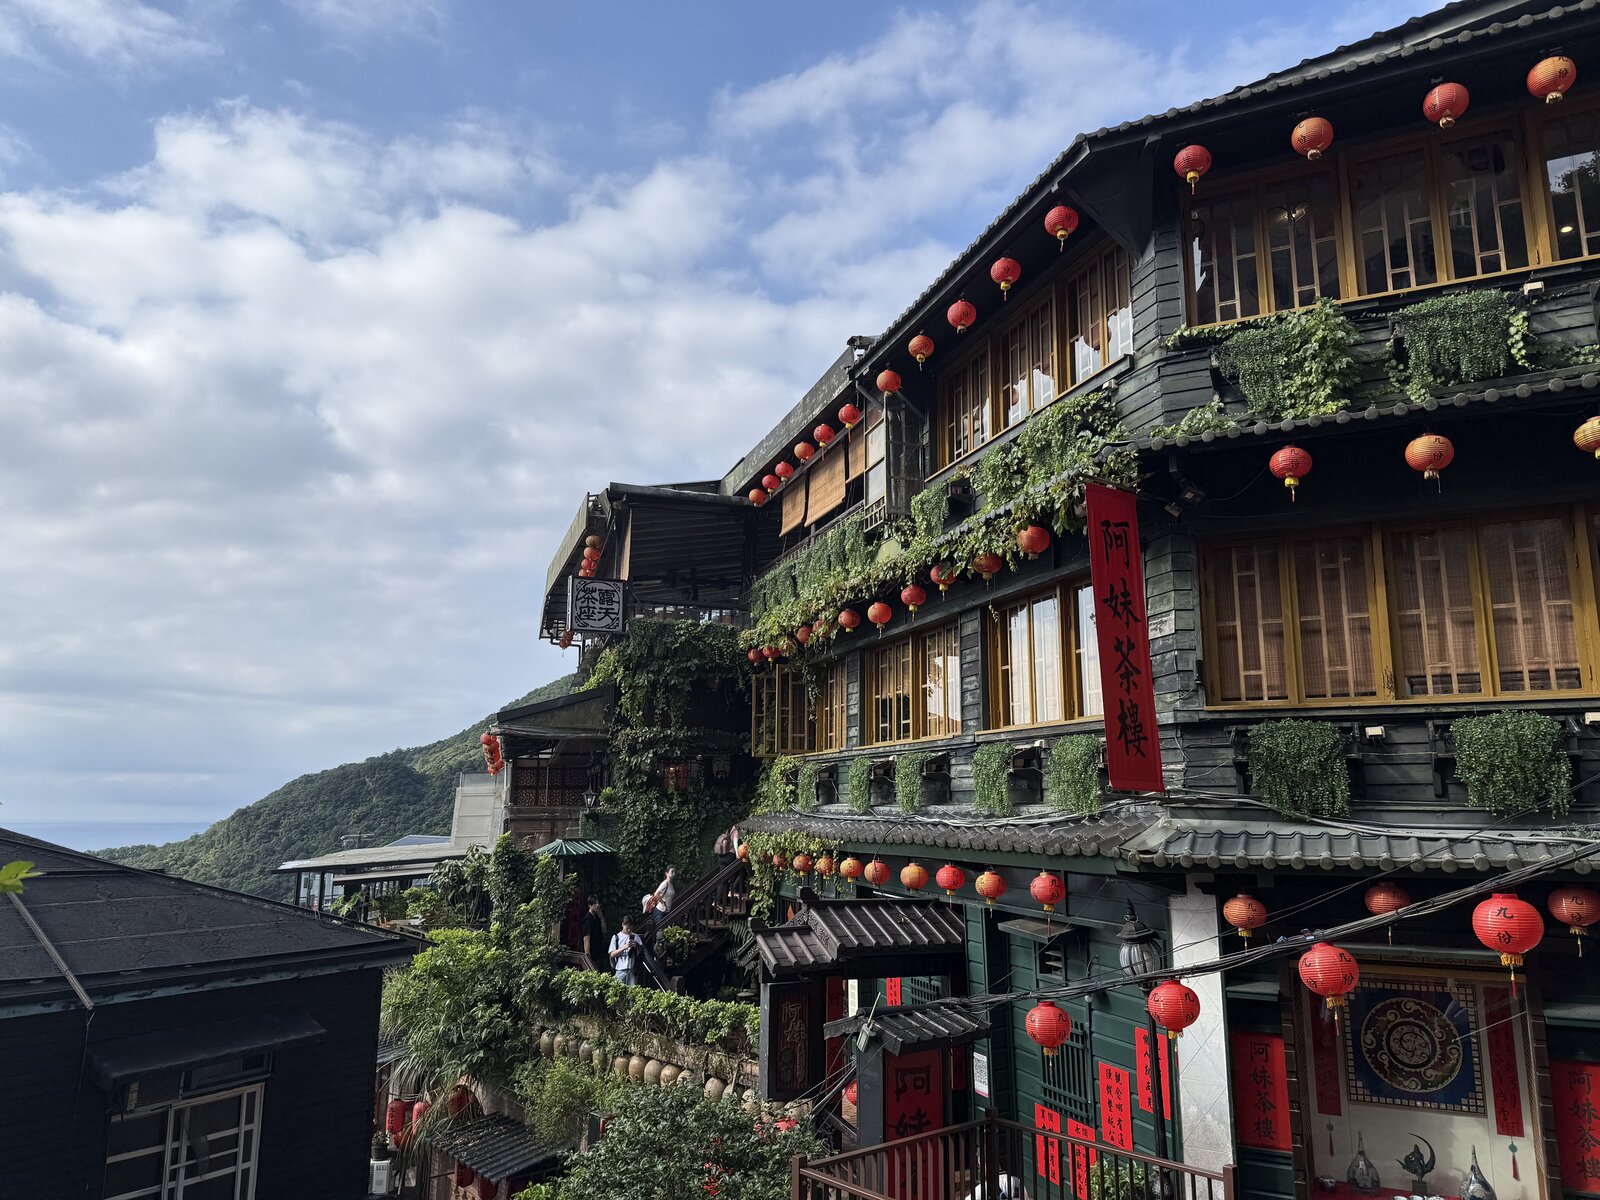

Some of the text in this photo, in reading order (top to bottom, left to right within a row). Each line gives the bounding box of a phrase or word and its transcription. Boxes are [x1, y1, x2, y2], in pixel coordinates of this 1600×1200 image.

[1290, 448, 1300, 469] 九份
[1433, 437, 1446, 461] 九份
[1100, 519, 1149, 759] 阿妹茶樓
[1051, 878, 1060, 901] 九份
[1496, 906, 1514, 944] 九份
[1570, 896, 1584, 922] 九份
[1338, 952, 1355, 986] 九份
[1184, 992, 1196, 1023] 九份
[1249, 1041, 1277, 1140] 阿妹茶樓
[1568, 1071, 1600, 1179] 阿妹茶樓
